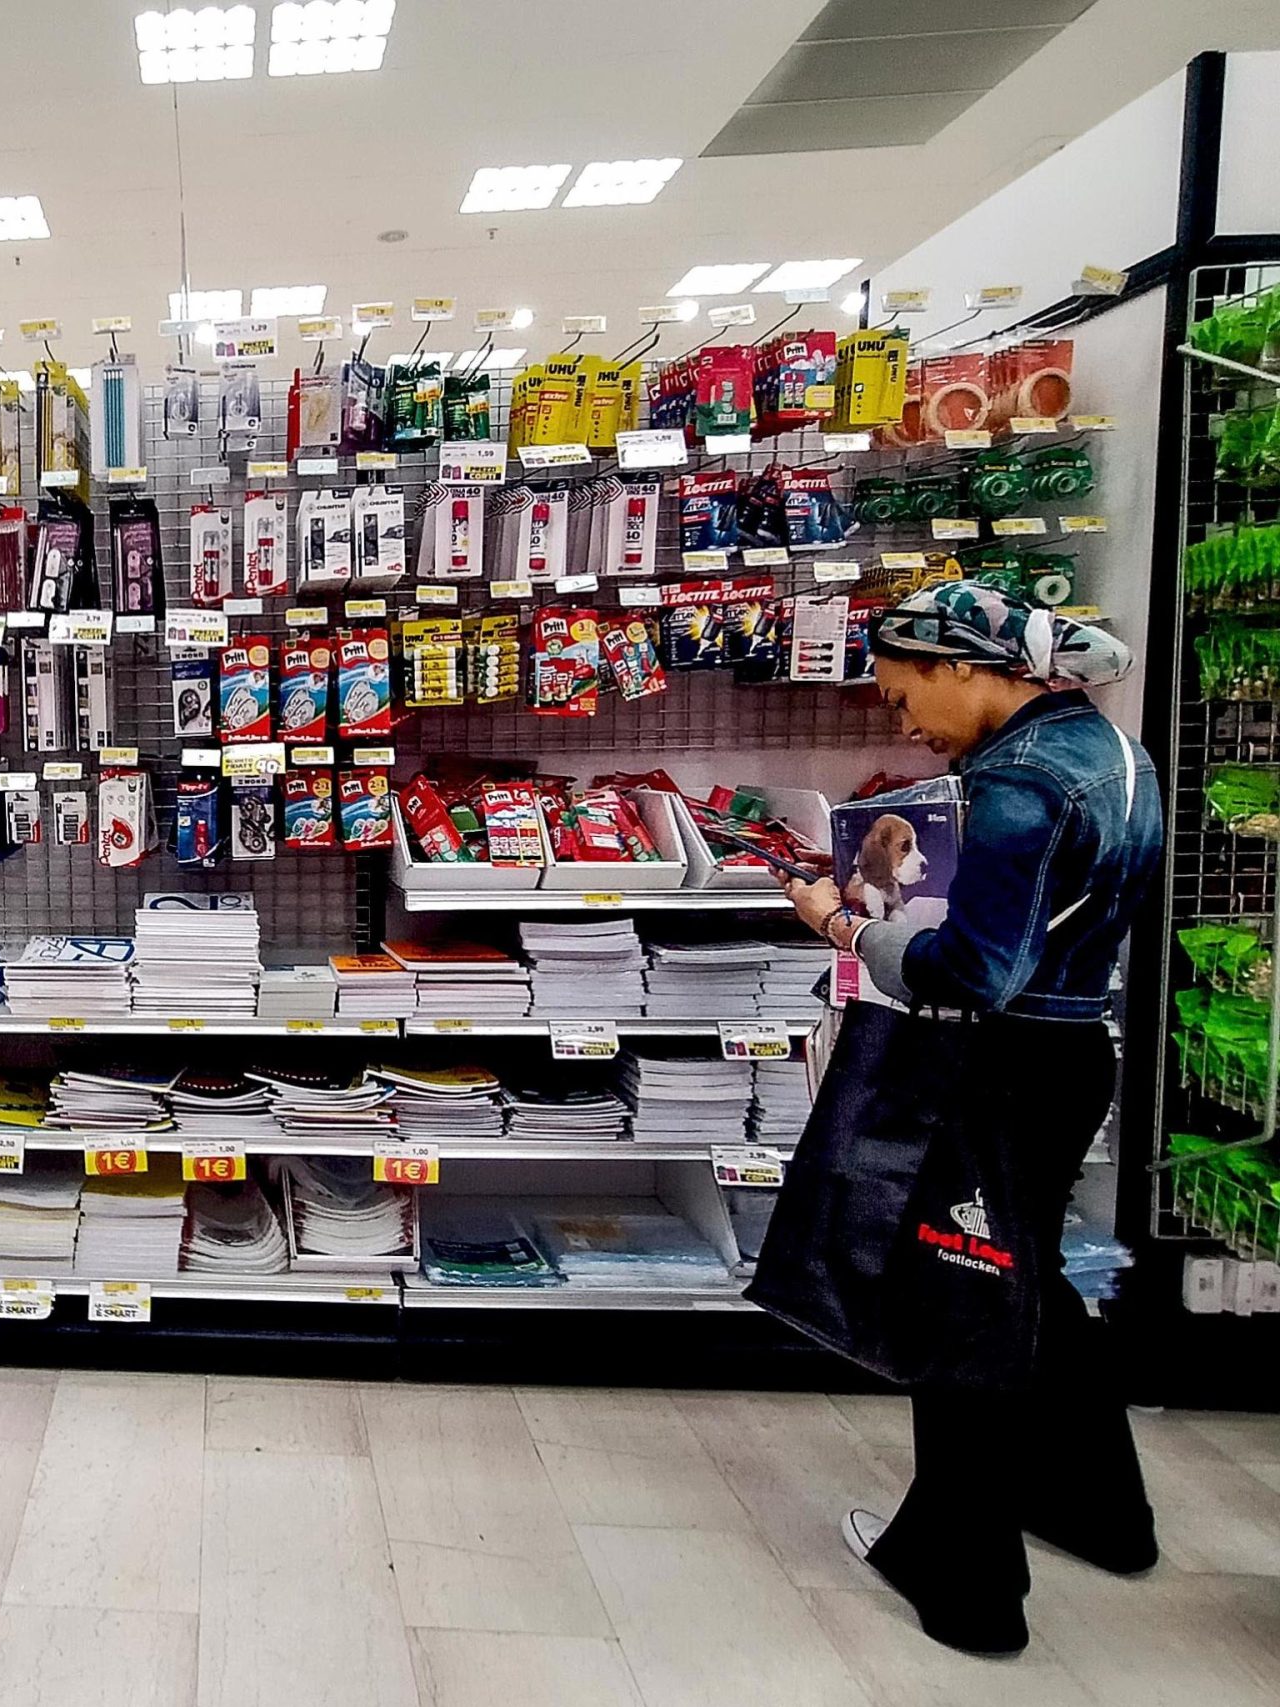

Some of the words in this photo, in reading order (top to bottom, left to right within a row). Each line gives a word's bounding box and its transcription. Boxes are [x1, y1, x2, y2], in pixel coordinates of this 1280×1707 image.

[786, 346, 804, 355] Pritt
[858, 341, 885, 351] UHU
[548, 365, 576, 375] UHU
[684, 479, 734, 495] LOCTITE
[783, 479, 827, 489] LOCTITE
[467, 487, 480, 495] 40
[192, 563, 203, 599] Pentel
[671, 589, 720, 601] LOCTITE
[722, 586, 772, 599] LOCTITE
[543, 621, 565, 633] Pritt
[606, 634, 625, 647] Pritt
[344, 645, 365, 657] Pritt
[225, 652, 245, 664] Pritt
[287, 654, 307, 665] Pritt
[288, 782, 305, 791] Pritt
[344, 783, 360, 792] Pritt
[488, 793, 509, 802] Pritt
[100, 829, 111, 866] Pentel
[412, 1148, 428, 1156] 1,00
[100, 1152, 132, 1170] 1€
[198, 1159, 227, 1177] 1€
[391, 1160, 422, 1179] 1€
[5, 1306, 38, 1315] SMART
[104, 1310, 137, 1318] SMART
